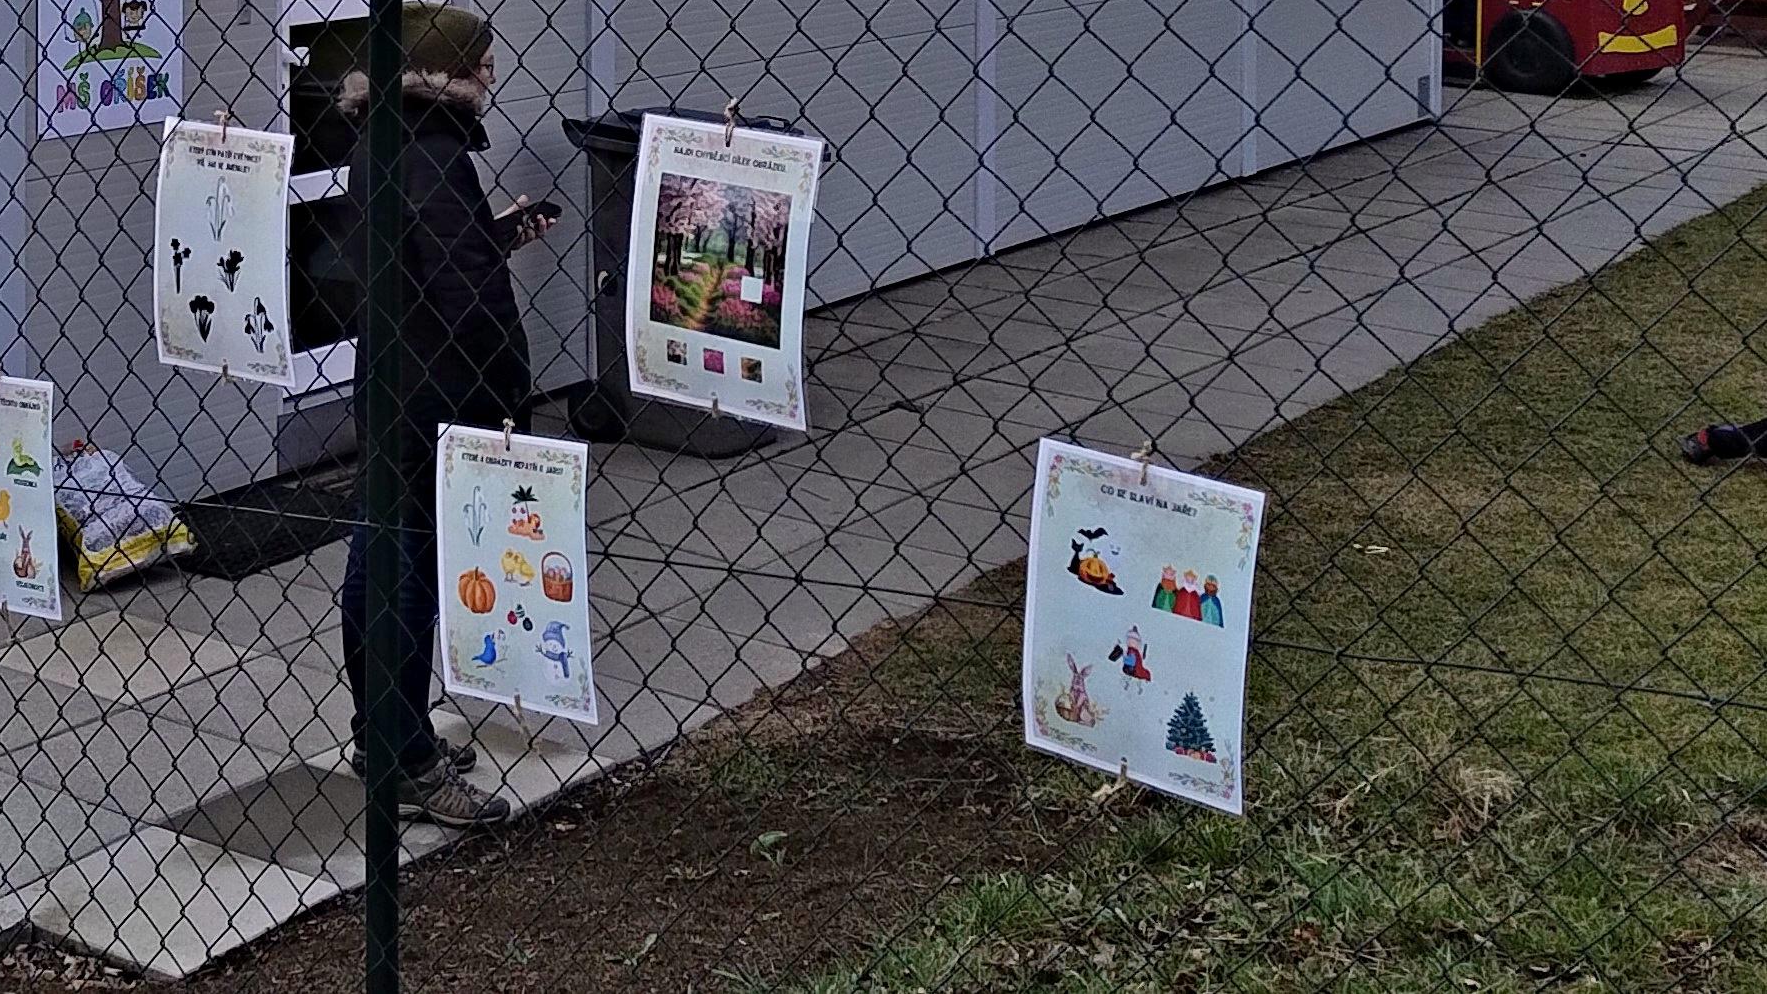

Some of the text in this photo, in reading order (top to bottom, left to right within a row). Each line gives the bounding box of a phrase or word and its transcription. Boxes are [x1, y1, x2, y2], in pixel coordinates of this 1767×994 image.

[56, 66, 170, 113] MŠ OŘÍŠEK
[1100, 484, 1114, 495] CO
